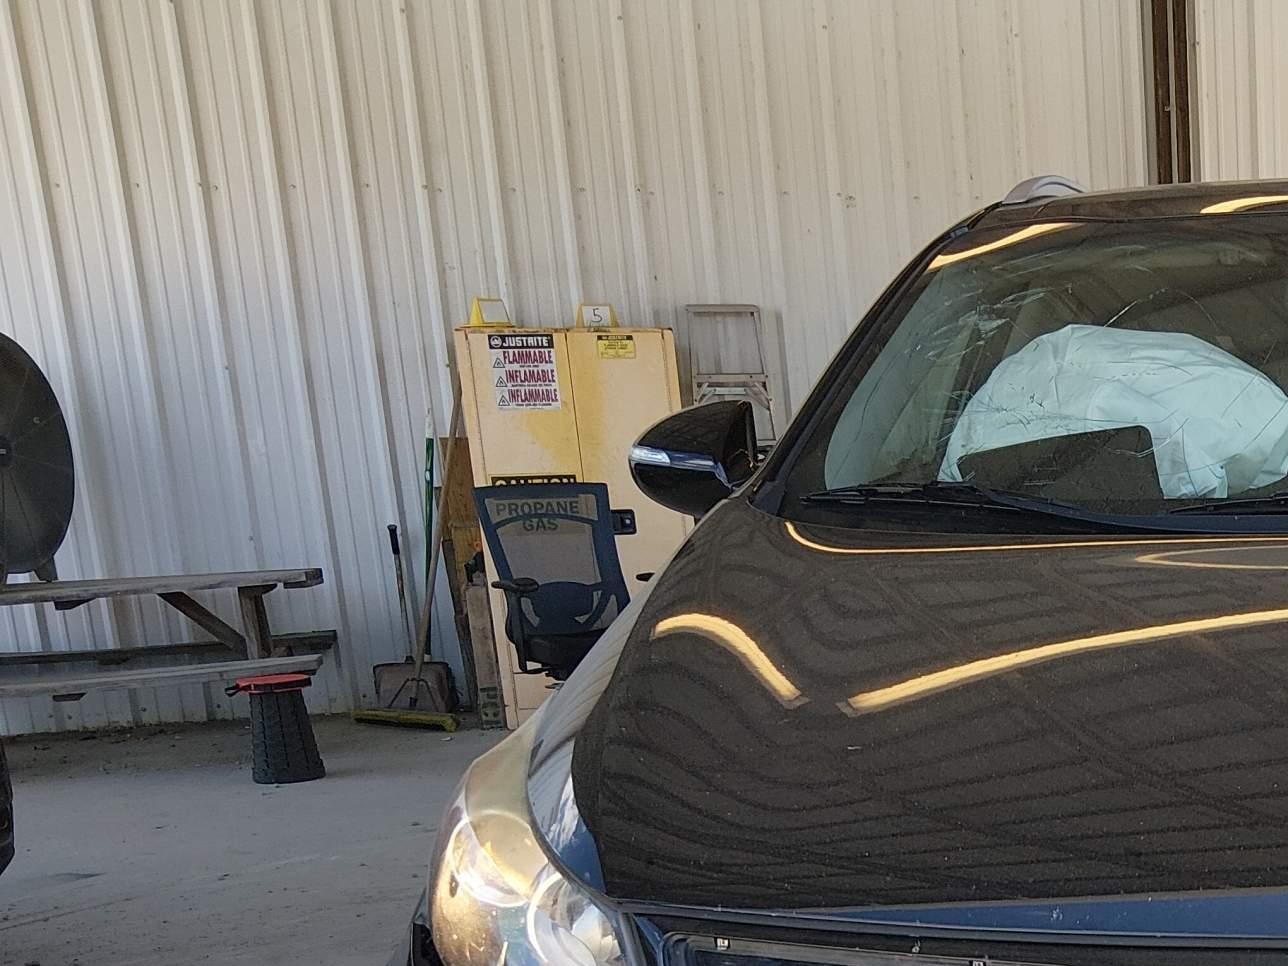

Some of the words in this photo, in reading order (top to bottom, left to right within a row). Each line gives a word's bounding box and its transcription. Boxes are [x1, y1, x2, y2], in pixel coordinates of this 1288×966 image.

[591, 307, 603, 323] 5
[502, 336, 549, 347] JUSTRITE
[502, 349, 554, 365] FLAMMABLE
[505, 369, 556, 384] INFLAMABLE
[507, 388, 559, 403] INFLAMMABLE
[495, 500, 580, 516] PROPANE
[522, 518, 559, 532] GAS
